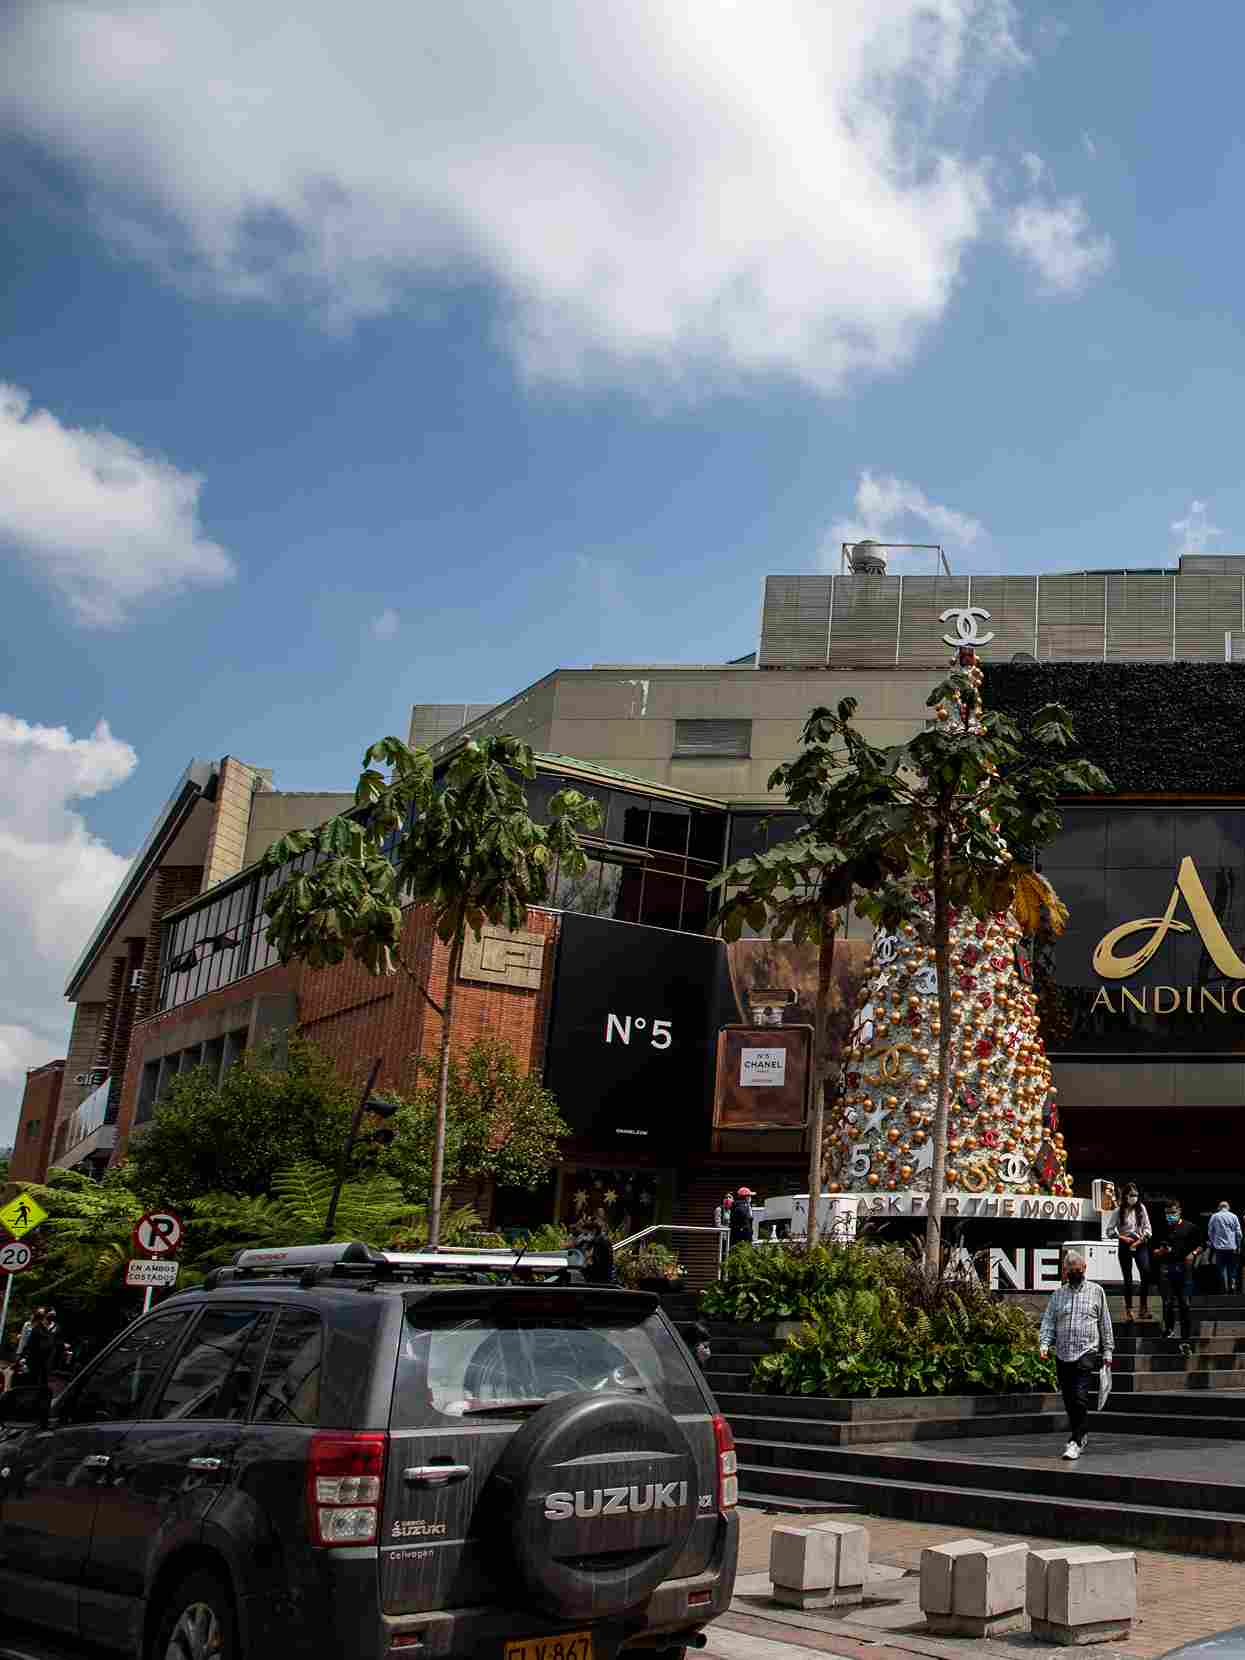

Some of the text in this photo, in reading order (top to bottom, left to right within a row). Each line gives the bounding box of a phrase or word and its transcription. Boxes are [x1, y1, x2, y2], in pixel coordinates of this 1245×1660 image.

[744, 1060, 783, 1069] CHANEL
[911, 1197, 960, 1217] FR
[967, 1198, 1017, 1217] THE
[1023, 1200, 1081, 1218] MOON
[2, 1249, 29, 1265] 20
[544, 1480, 688, 1520] SUZUKI
[391, 1524, 447, 1537] SUZUKI
